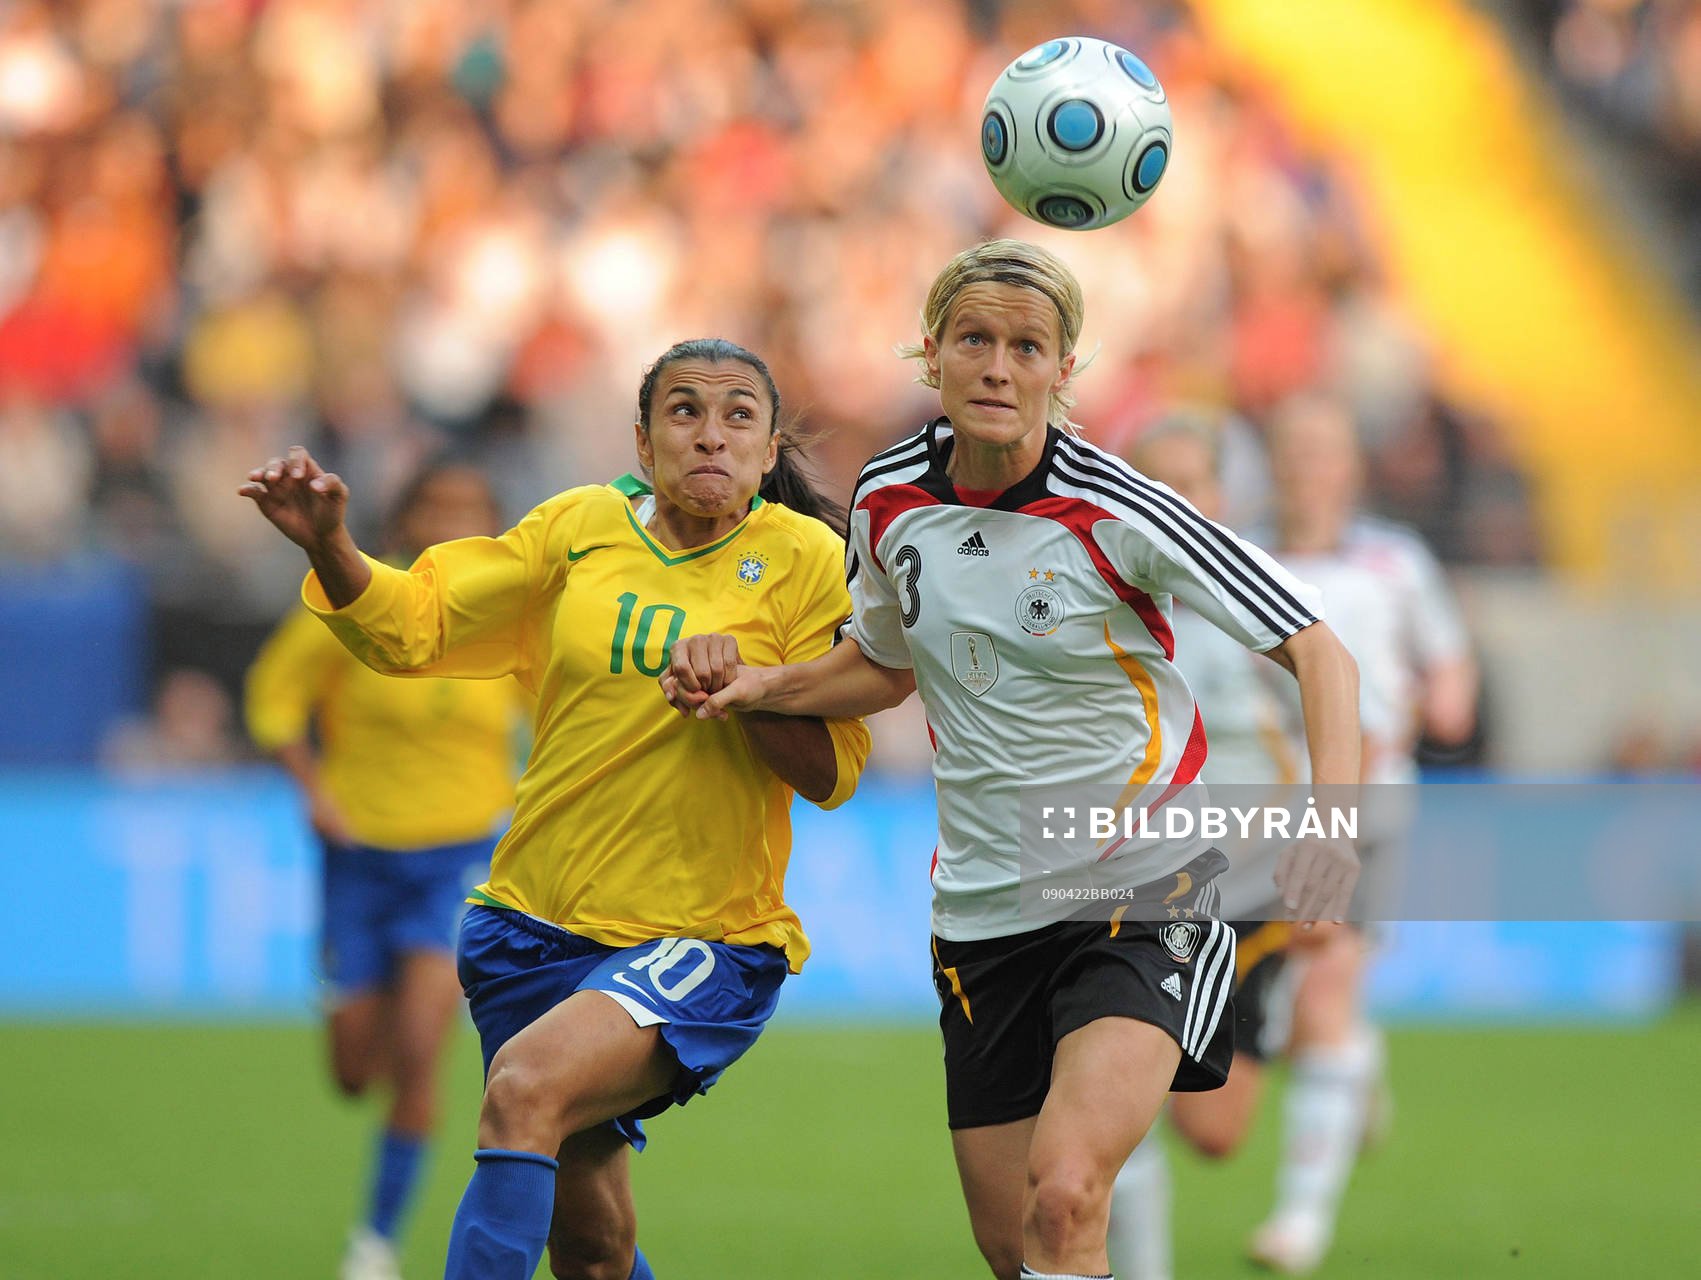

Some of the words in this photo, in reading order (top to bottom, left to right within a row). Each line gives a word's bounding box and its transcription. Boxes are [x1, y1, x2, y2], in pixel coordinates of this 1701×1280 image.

[895, 544, 922, 628] 3
[957, 546, 990, 557] adidas
[610, 591, 687, 678] 10
[628, 937, 716, 1002] 10
